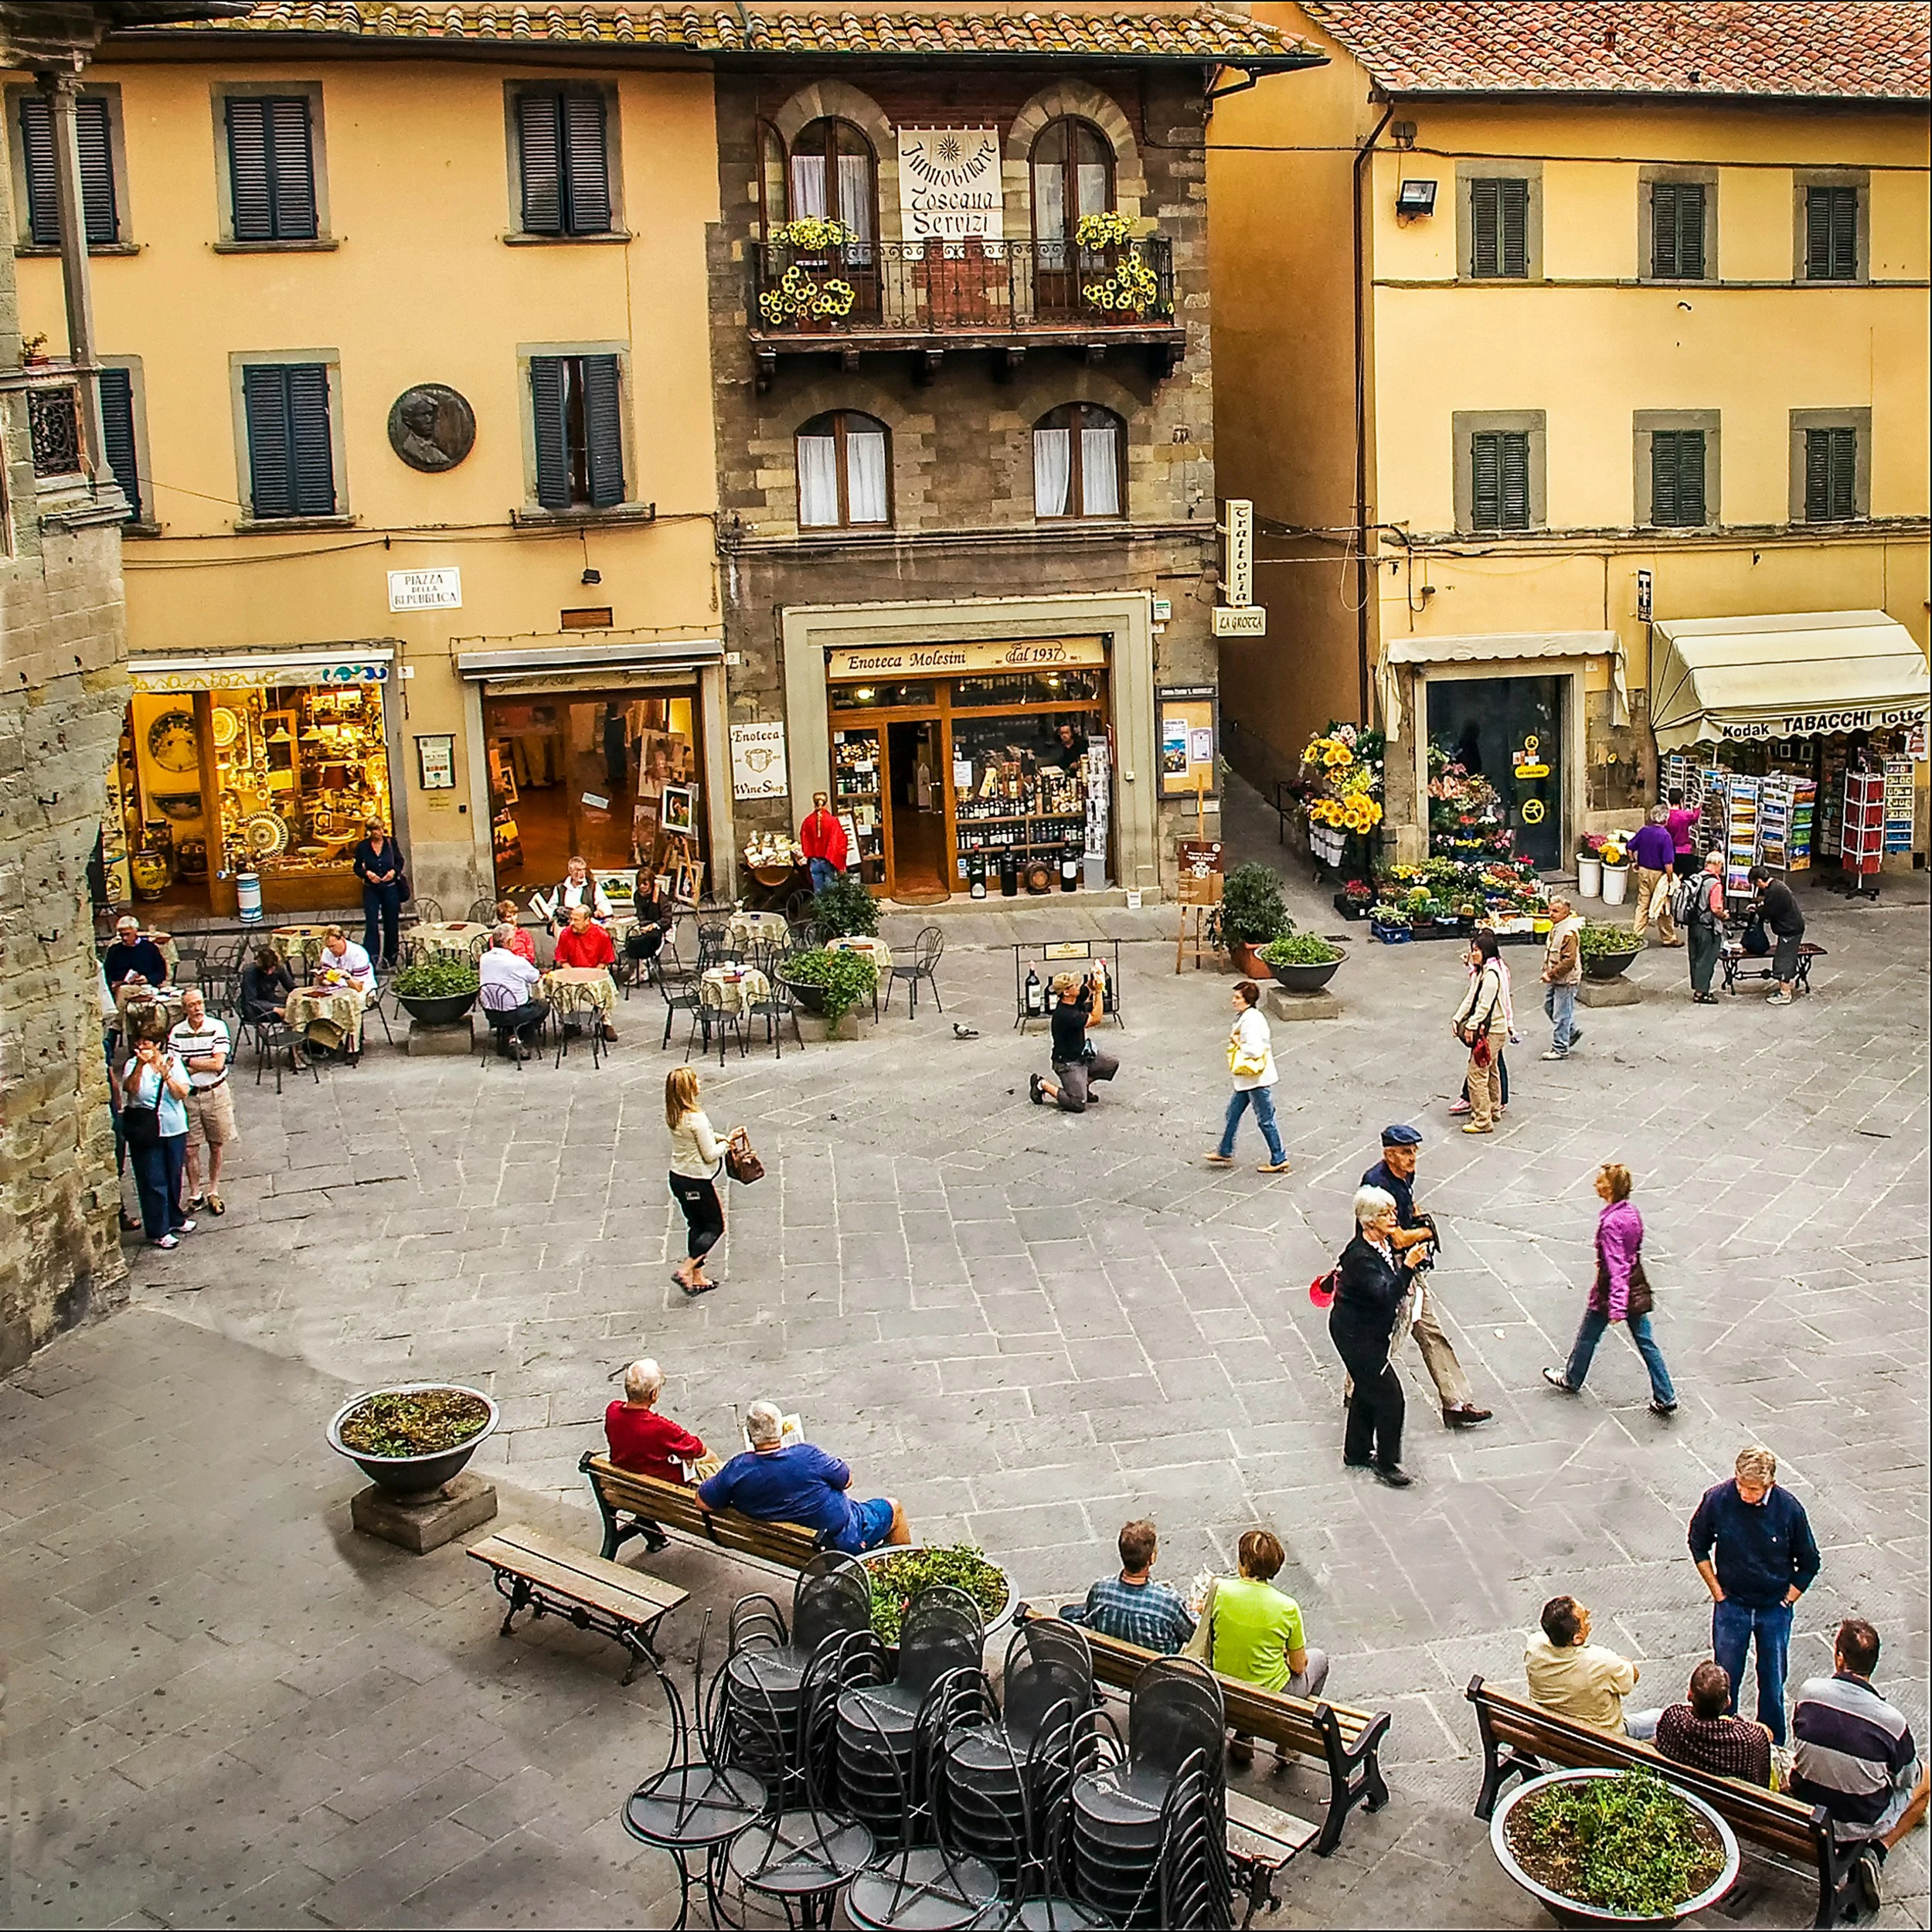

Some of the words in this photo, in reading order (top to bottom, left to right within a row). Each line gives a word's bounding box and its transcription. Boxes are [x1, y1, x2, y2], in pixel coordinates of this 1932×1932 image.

[911, 186, 993, 211] Toscana
[913, 213, 988, 234] Servizi
[1234, 506, 1249, 600] Trattoria
[404, 574, 443, 585] PIAZZA
[394, 592, 457, 604] REPUBBLICA
[1232, 616, 1262, 631] GROTTA
[848, 655, 902, 670] Enoteca
[910, 650, 966, 667] Molesini
[1009, 647, 1031, 663] dal
[1032, 648, 1061, 662] 1937
[1722, 723, 1770, 737] Kodak
[1782, 710, 1872, 733] TABACCHI
[1882, 709, 1924, 724] lotto
[733, 730, 780, 742] Enoteca
